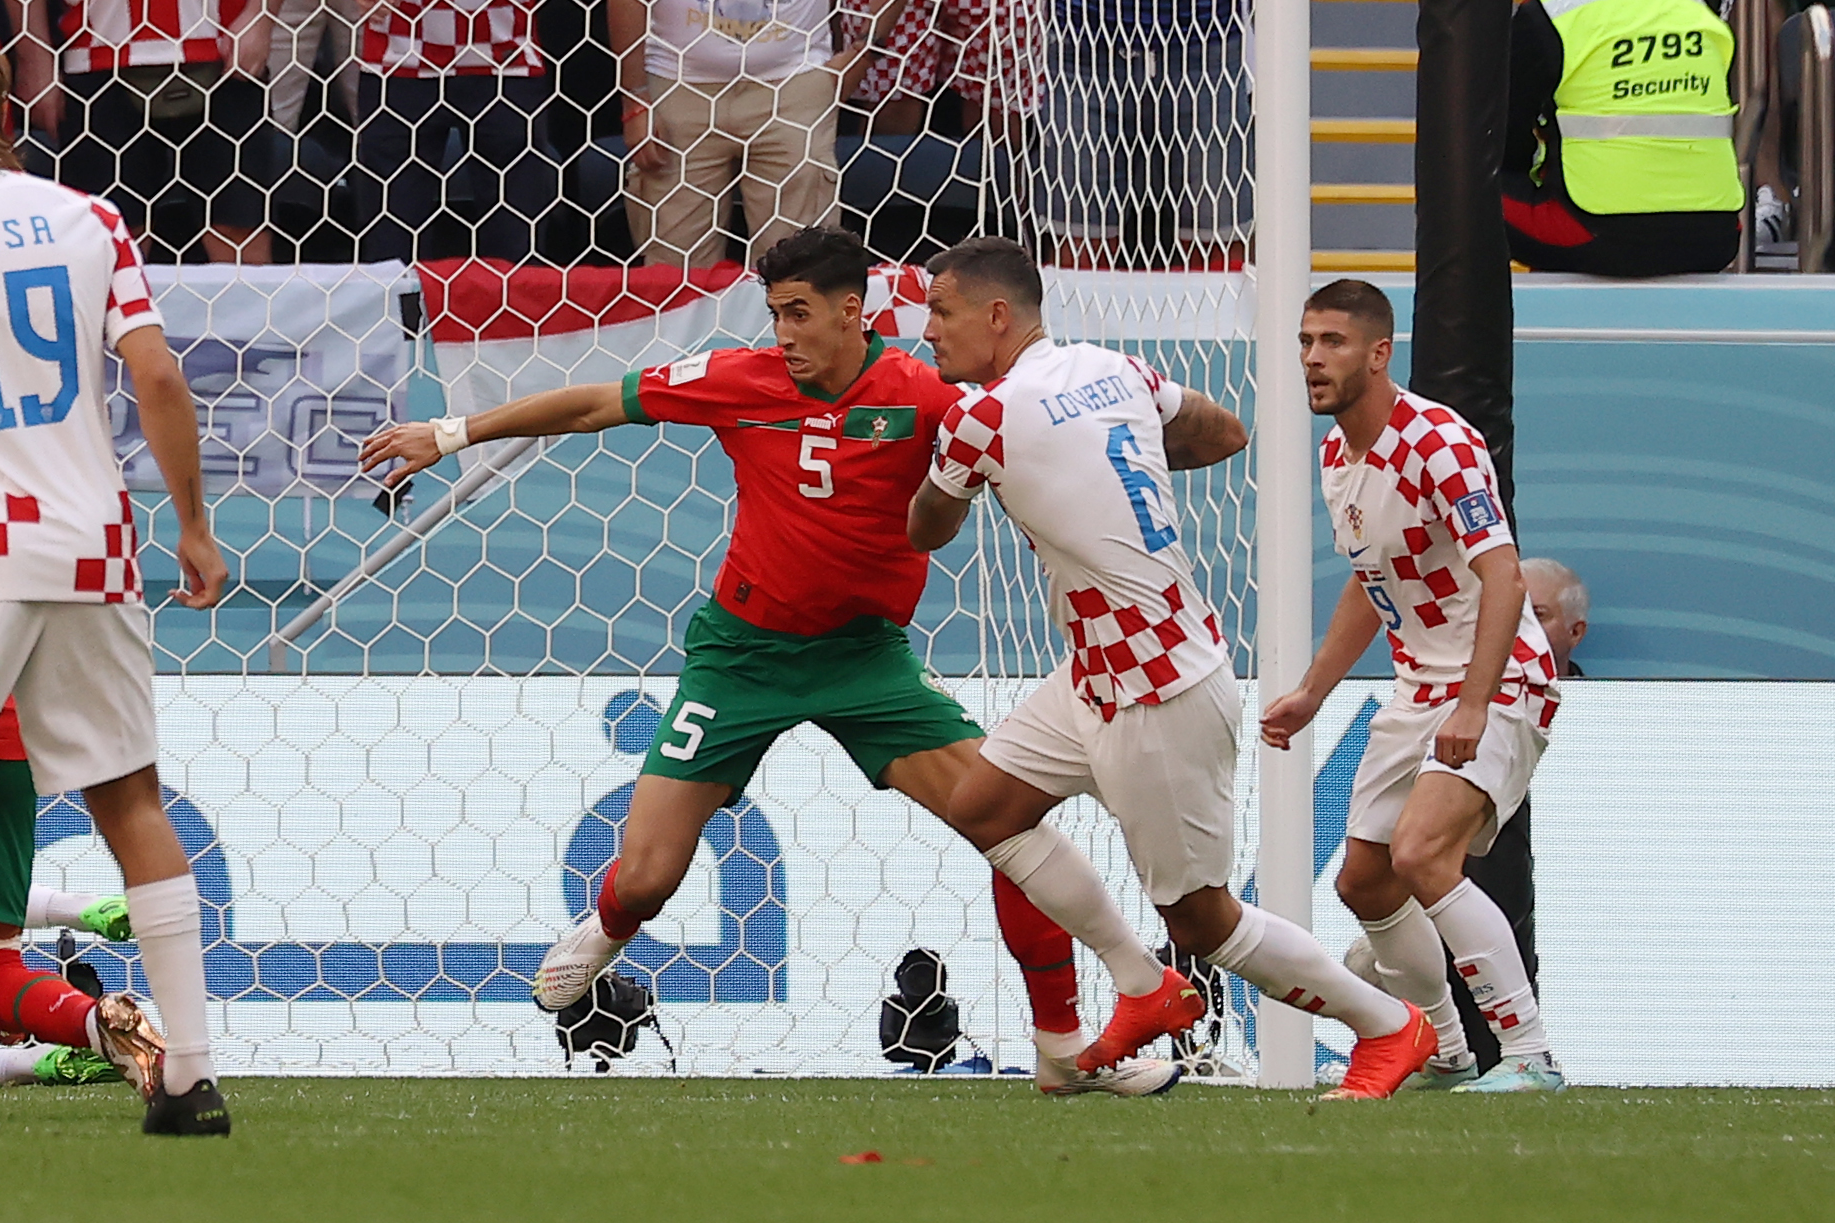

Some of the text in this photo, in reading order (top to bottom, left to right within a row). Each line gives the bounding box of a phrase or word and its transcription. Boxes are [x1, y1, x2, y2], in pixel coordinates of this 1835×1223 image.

[1611, 31, 1704, 70] 2793
[1612, 73, 1711, 100] Security
[1040, 375, 1133, 426] LOVREN
[798, 434, 837, 499] 5
[1105, 422, 1178, 554] 6
[1366, 585, 1402, 631] 9
[659, 701, 717, 761] 5
